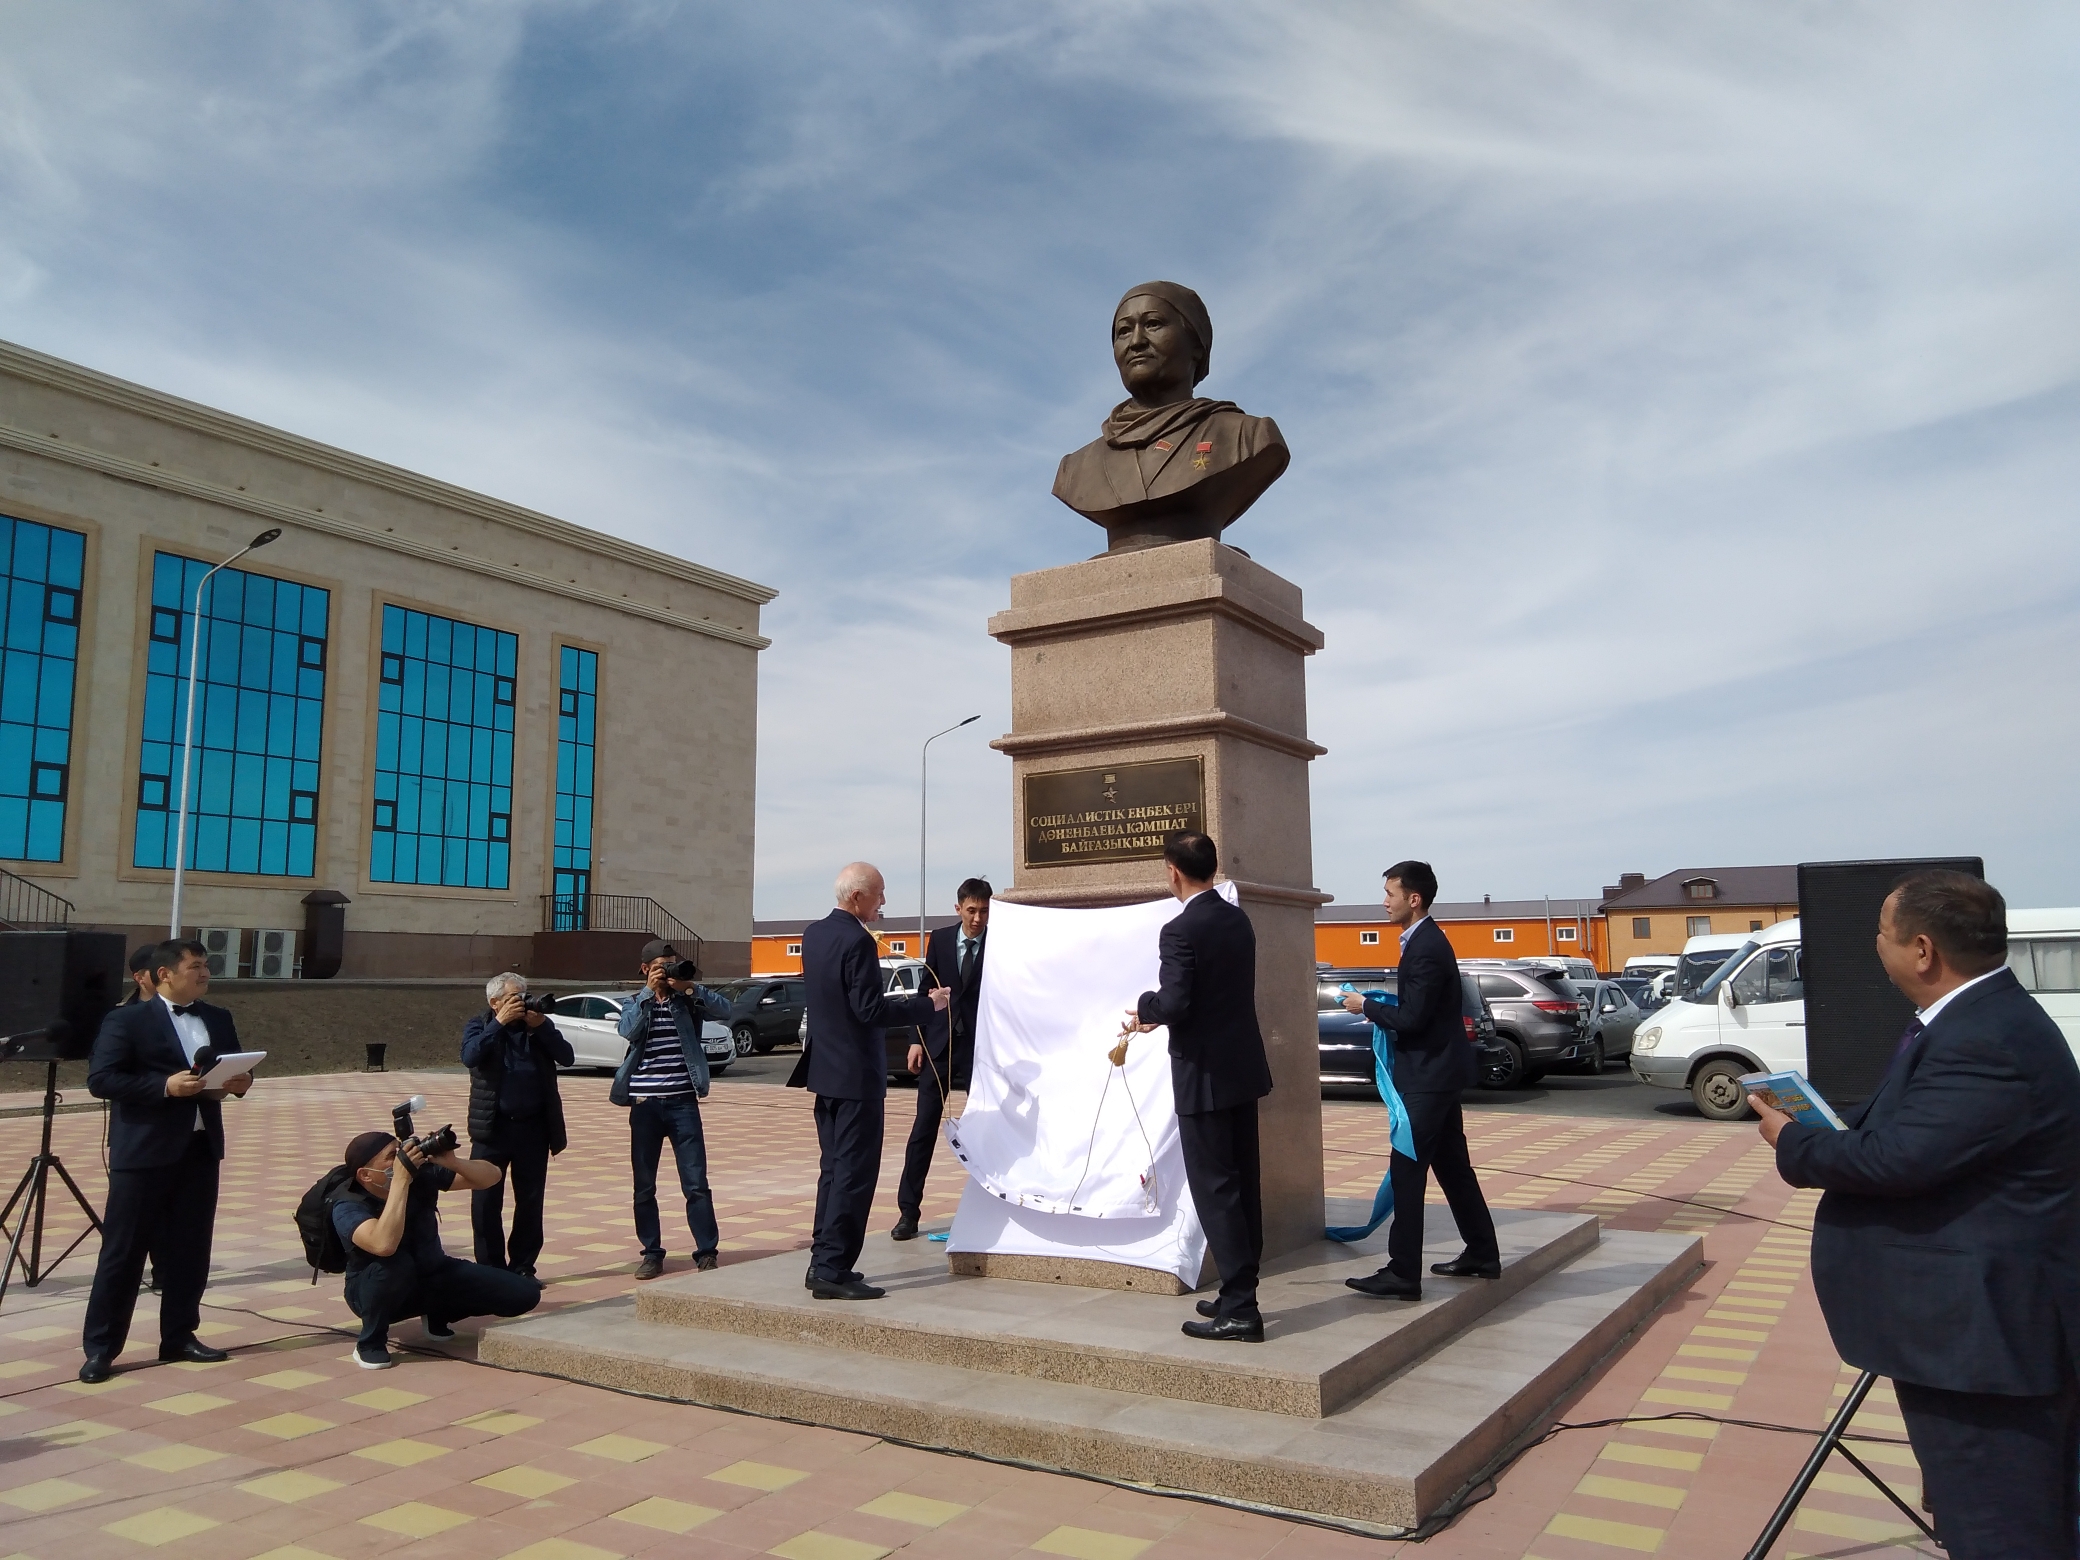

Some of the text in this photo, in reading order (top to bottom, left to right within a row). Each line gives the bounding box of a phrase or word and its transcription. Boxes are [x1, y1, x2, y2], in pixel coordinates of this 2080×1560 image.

[1030, 802, 1197, 828] СОЦИАЛИСТІК ЕҢБЕК ЕРІ
[1038, 818, 1188, 843] ДӨНЕНБАЕВА КӘМШАТ
